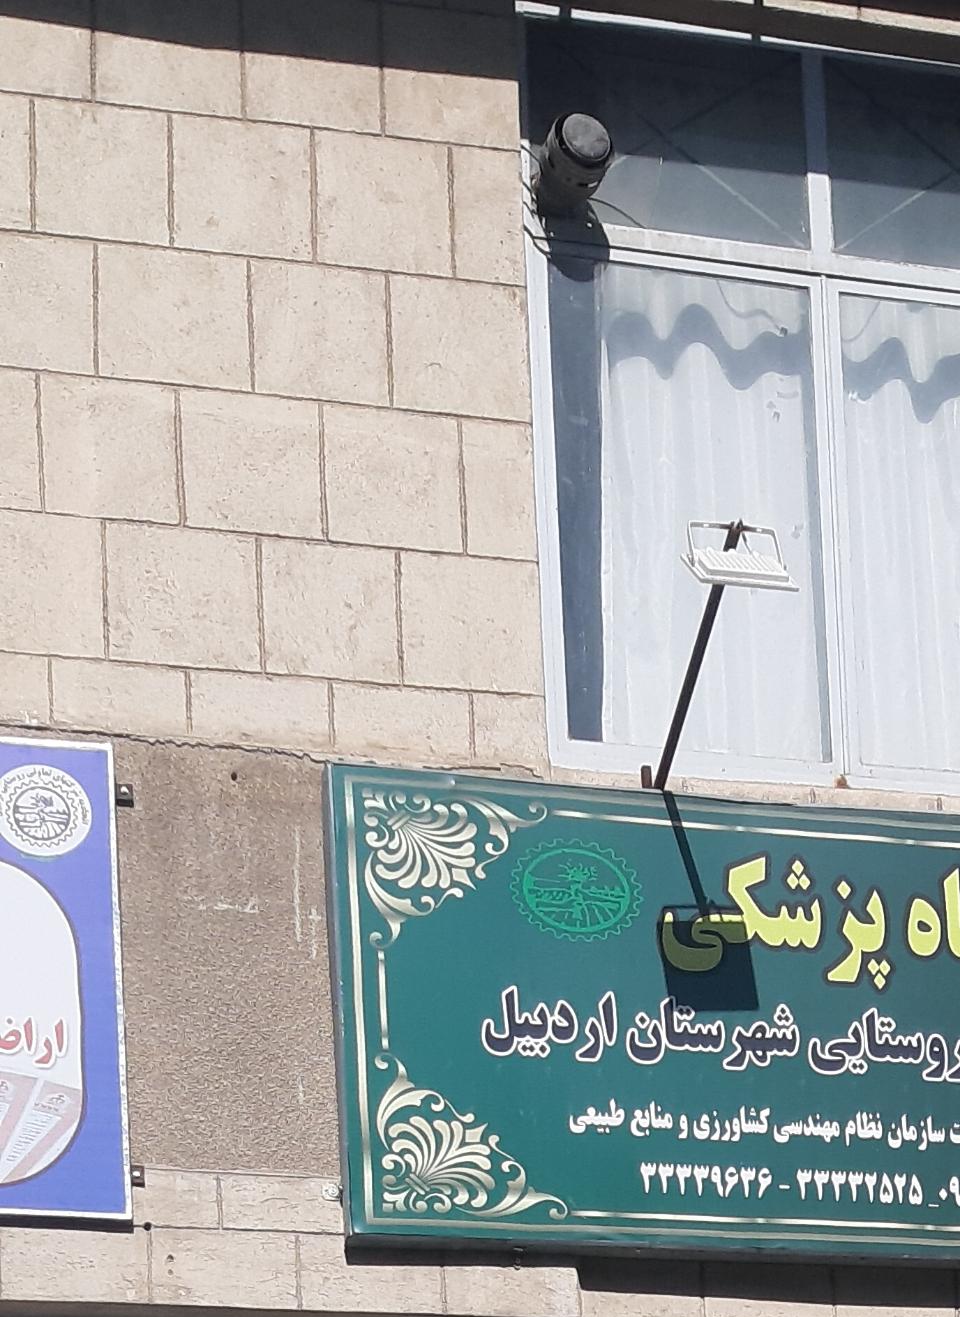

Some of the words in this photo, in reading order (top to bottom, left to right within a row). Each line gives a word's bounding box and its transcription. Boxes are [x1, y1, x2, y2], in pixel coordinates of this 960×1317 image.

[660, 855, 892, 990] پزشکی
[480, 984, 618, 1064] اردبیل
[626, 994, 799, 1071] شهرستان
[568, 1097, 626, 1134] طبیعی
[630, 1099, 674, 1138] منابع
[678, 1112, 689, 1139] و
[693, 1104, 771, 1142] کشاورزی
[773, 1112, 841, 1144] مهندسی
[844, 1109, 884, 1147] نظام
[887, 1113, 946, 1151] سازمان
[639, 1161, 773, 1199] ۳۳۳۳۹۶۳۶
